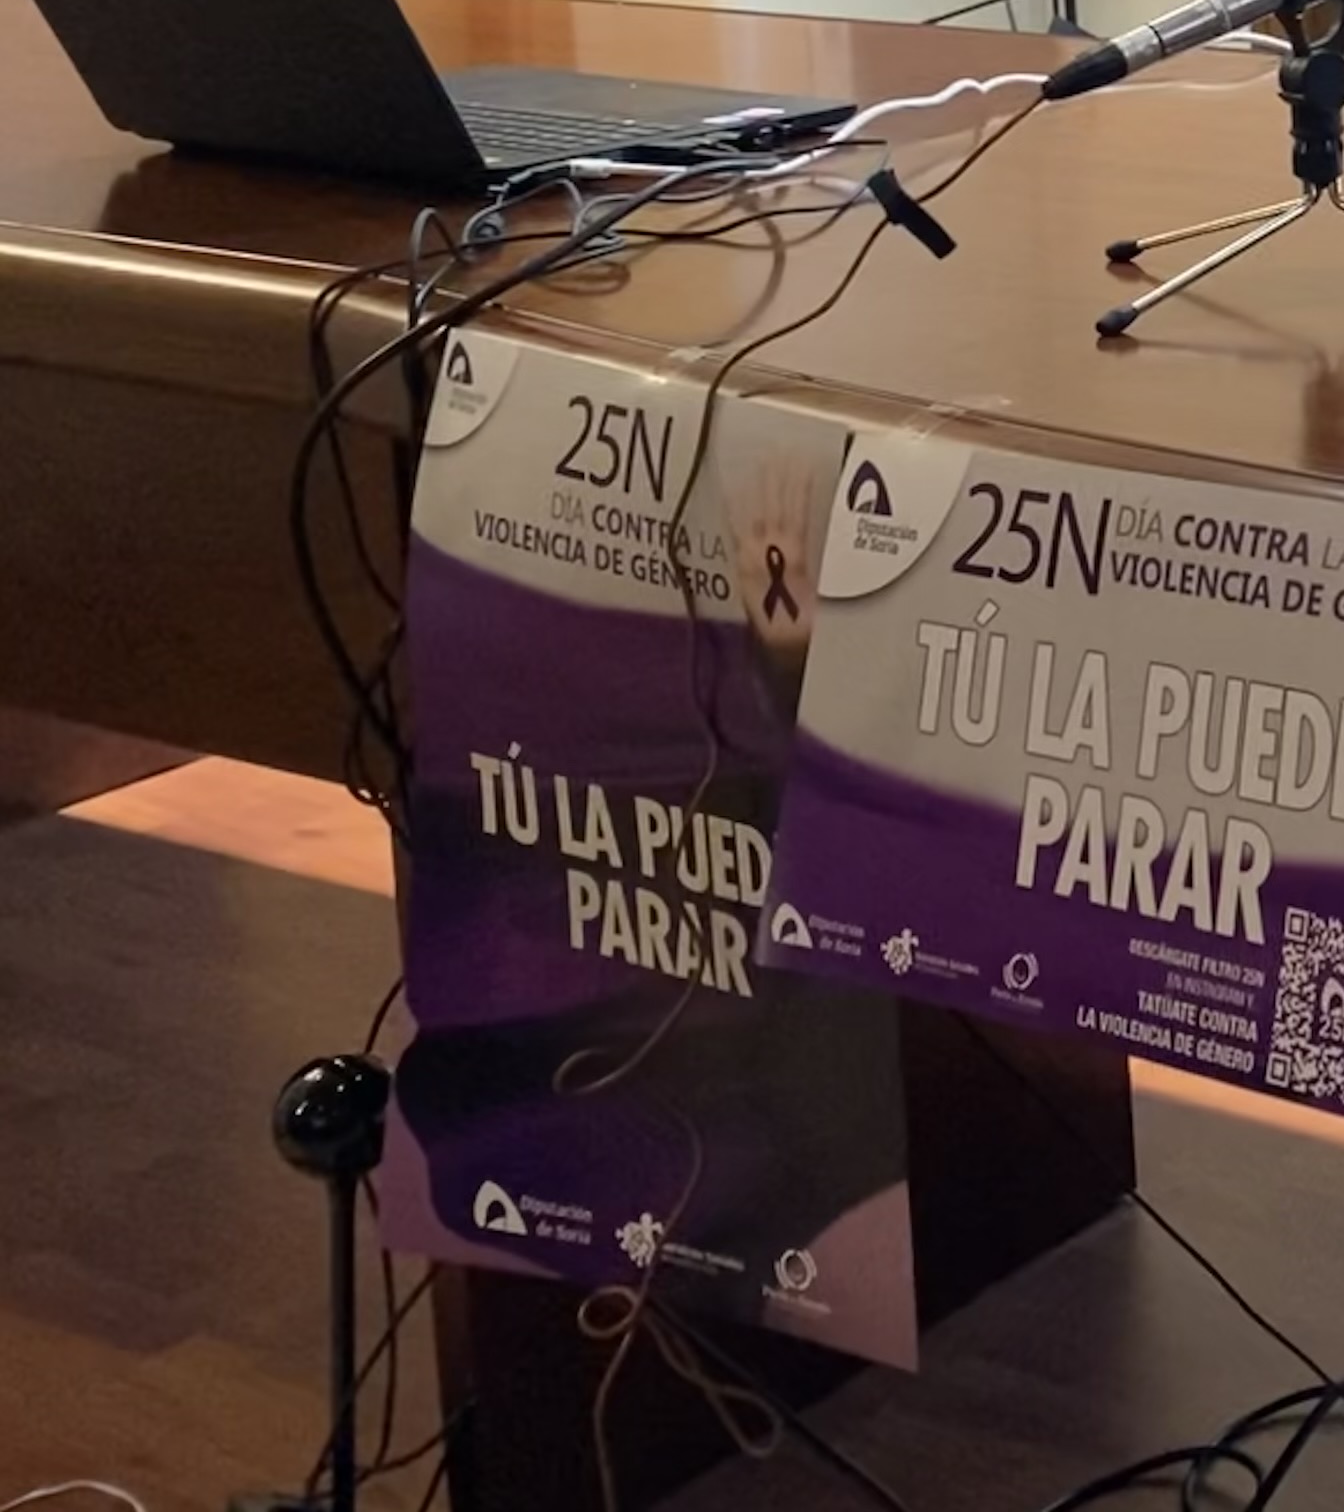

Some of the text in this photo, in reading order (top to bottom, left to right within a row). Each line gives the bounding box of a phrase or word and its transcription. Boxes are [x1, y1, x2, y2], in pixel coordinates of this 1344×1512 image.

[554, 394, 674, 503] 25N
[474, 509, 587, 567] VIOLENCIA
[594, 544, 625, 576] DE
[550, 489, 586, 528] DÍA
[699, 532, 729, 563] LA
[951, 482, 1113, 596] 25N
[1114, 501, 1165, 545] DÍA
[1173, 514, 1310, 568] CONTRA
[1109, 550, 1271, 609] VIOLENCIA
[1281, 579, 1322, 617] DE
[916, 598, 1008, 748] TÚ
[1025, 641, 1113, 771] LA
[470, 740, 773, 909] TÚ LA PUED
[1013, 773, 1273, 945] PARAR
[567, 868, 754, 998] PARAR
[1242, 967, 1265, 987] 25N
[1076, 1004, 1255, 1075] LA VIOLENCIA DE GÉNERO
[1199, 1005, 1258, 1043] CONTRA
